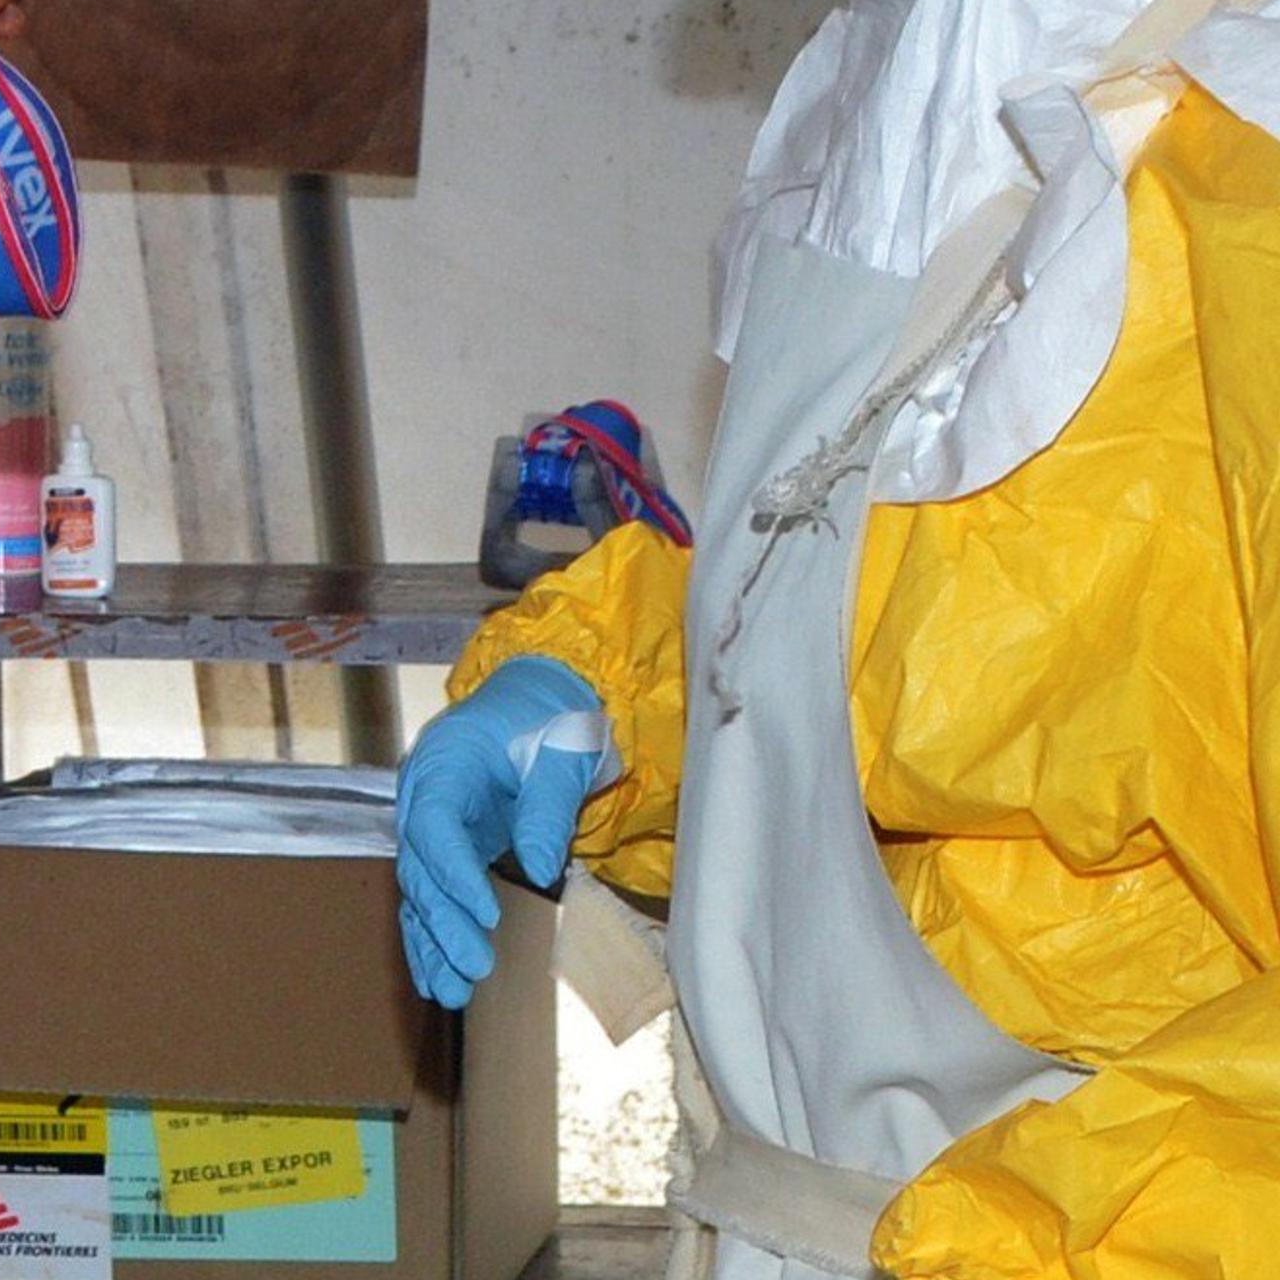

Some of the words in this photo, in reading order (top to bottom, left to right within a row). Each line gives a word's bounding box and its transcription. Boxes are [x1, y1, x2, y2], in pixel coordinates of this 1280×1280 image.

[170, 1160, 255, 1185] ZIEGLER
[263, 1150, 333, 1174] EXPOR
[15, 1245, 99, 1258] FRONTIERES
